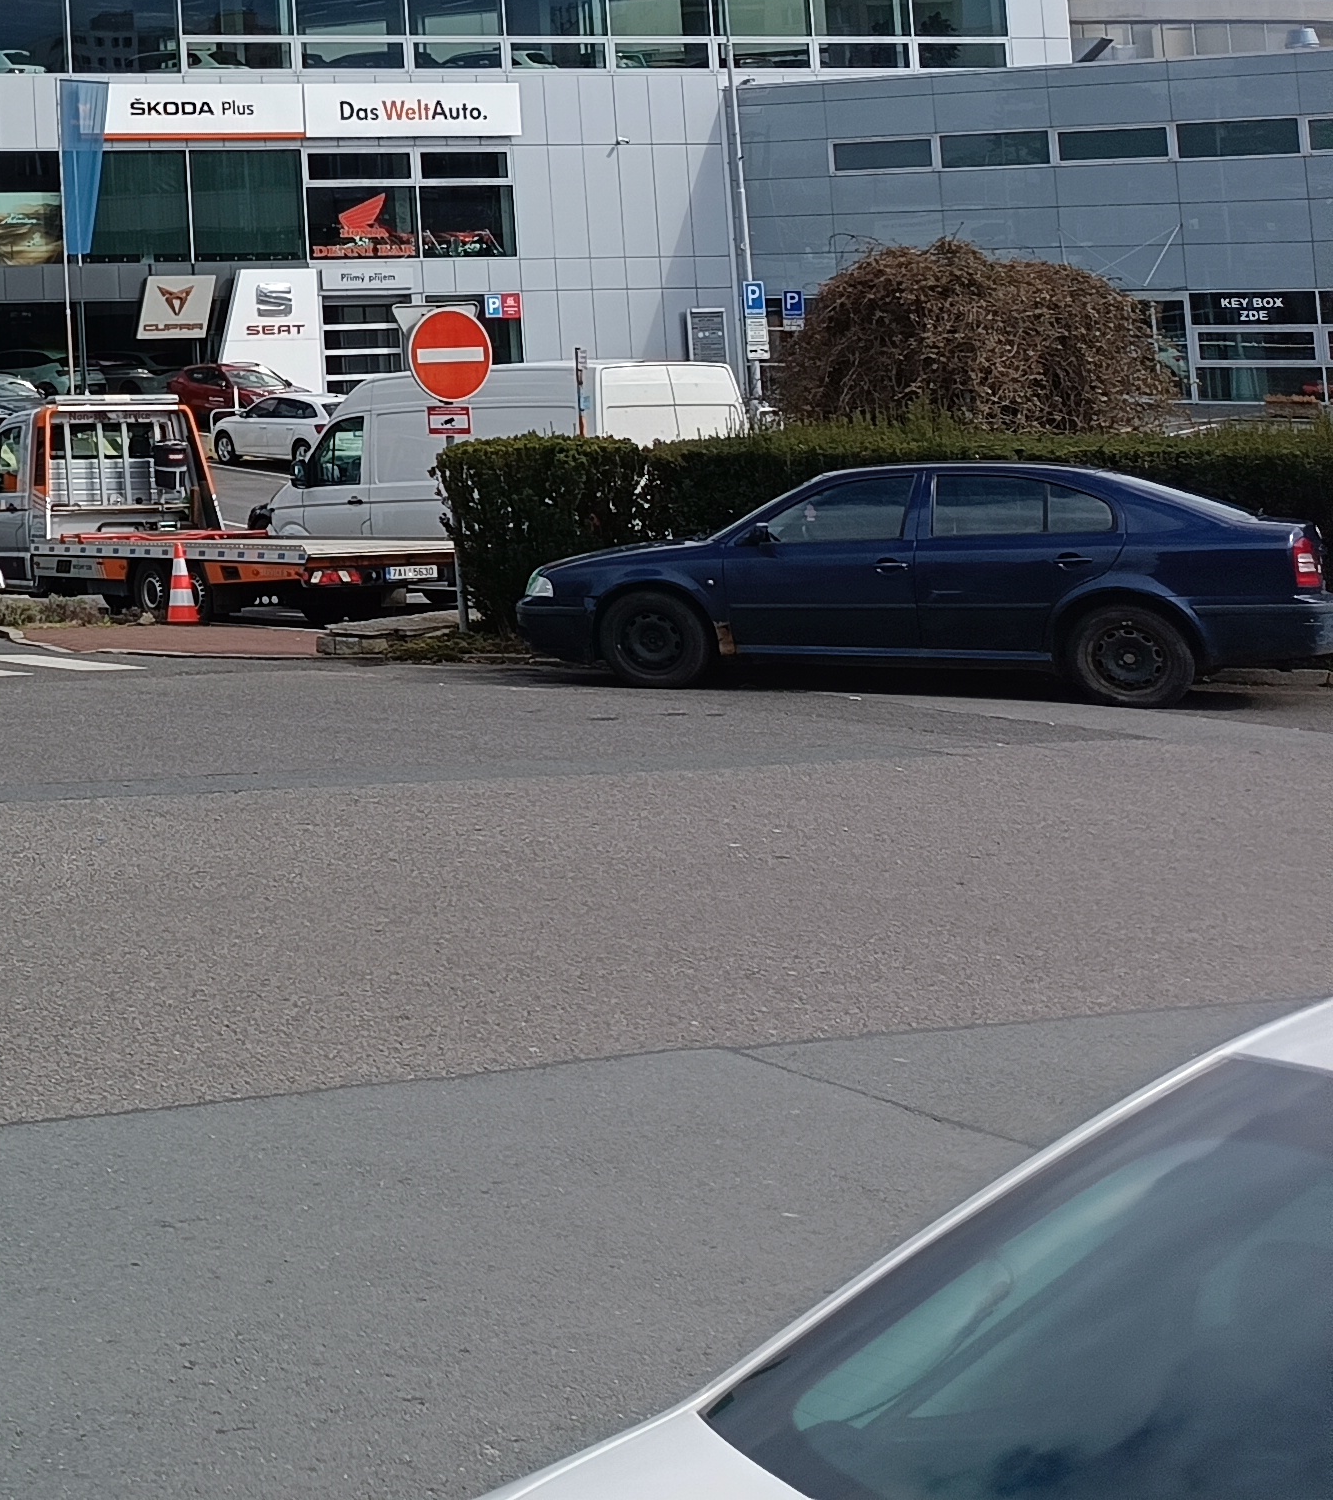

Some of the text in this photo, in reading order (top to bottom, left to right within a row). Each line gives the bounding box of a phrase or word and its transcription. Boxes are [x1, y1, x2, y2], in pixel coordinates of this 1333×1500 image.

[130, 98, 254, 116] ŠKODA Plus
[339, 99, 488, 121] Das WeltAuto.
[341, 272, 396, 283] Přímý příjem
[747, 285, 760, 306] P
[786, 292, 799, 309] P
[1220, 297, 1284, 308] KEY BOX
[488, 298, 500, 314] P
[1239, 310, 1270, 321] ZDE
[143, 323, 204, 332] CUPRA
[246, 324, 306, 336] SEAT
